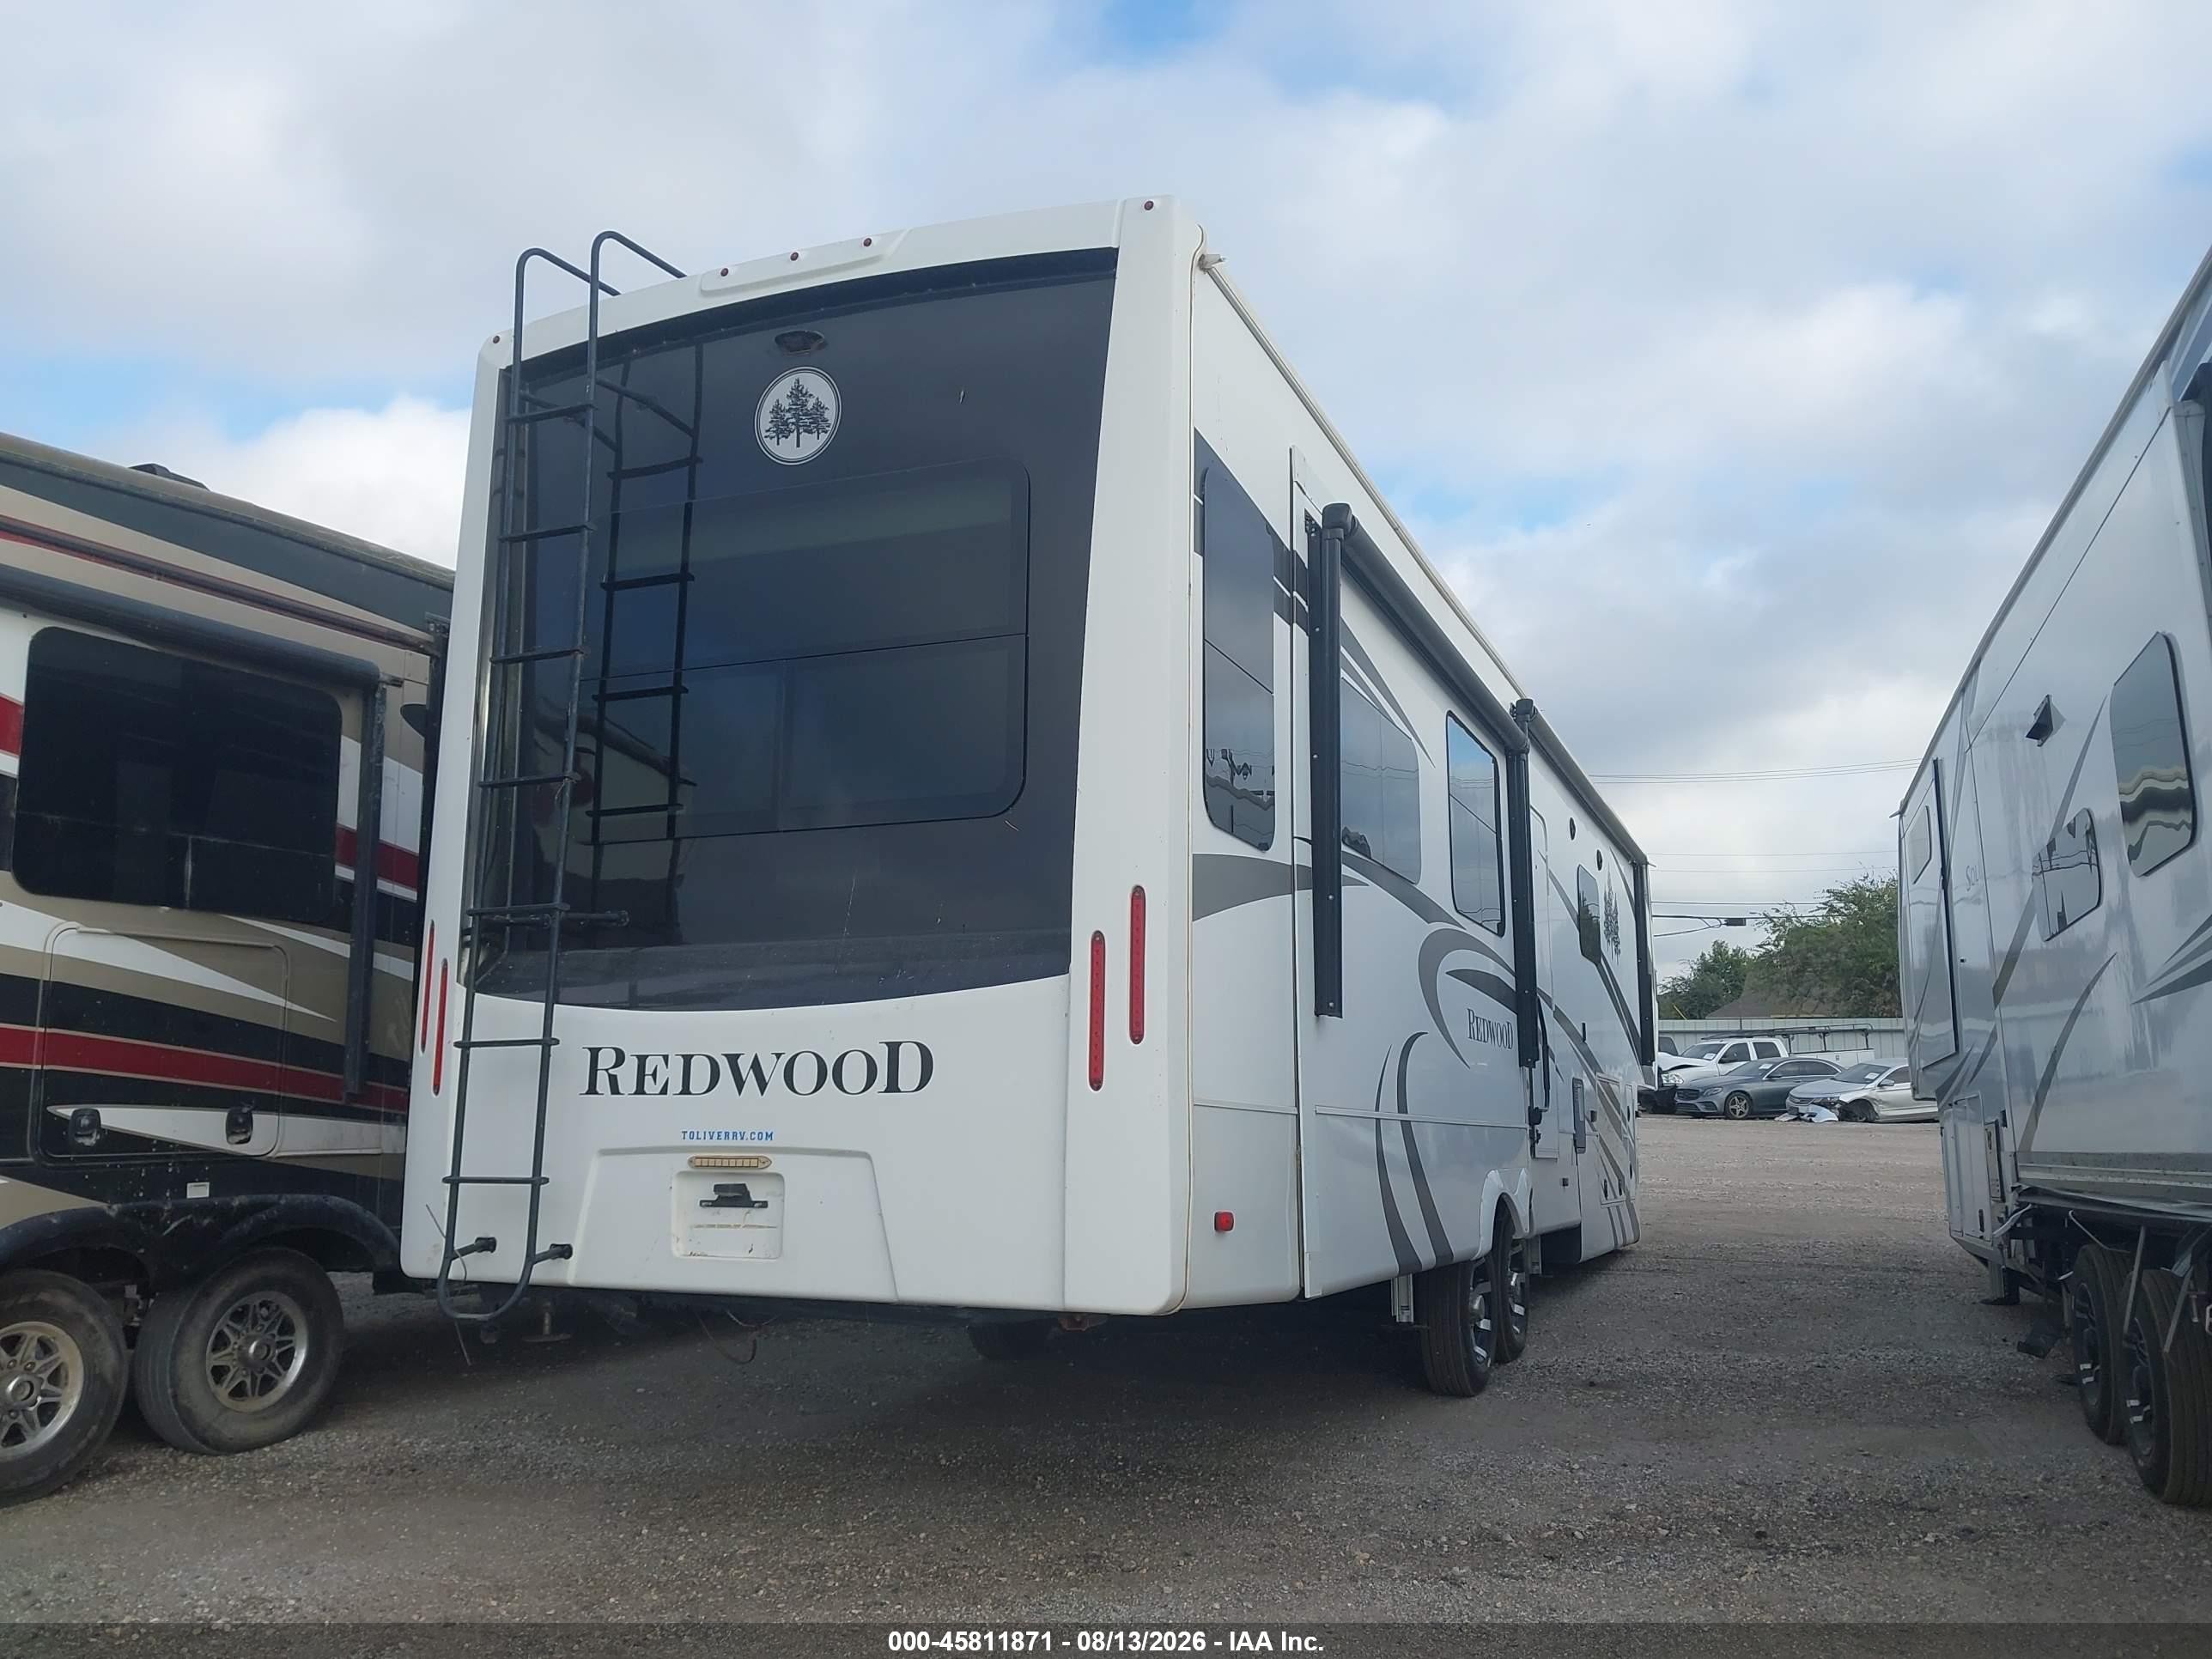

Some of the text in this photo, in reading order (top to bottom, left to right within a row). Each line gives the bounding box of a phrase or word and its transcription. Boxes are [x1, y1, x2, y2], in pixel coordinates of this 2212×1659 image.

[1467, 1008, 1514, 1049] REDWOOD
[580, 1040, 934, 1097] REDWOOD
[681, 1130, 775, 1141] TOLIVERRV.COM
